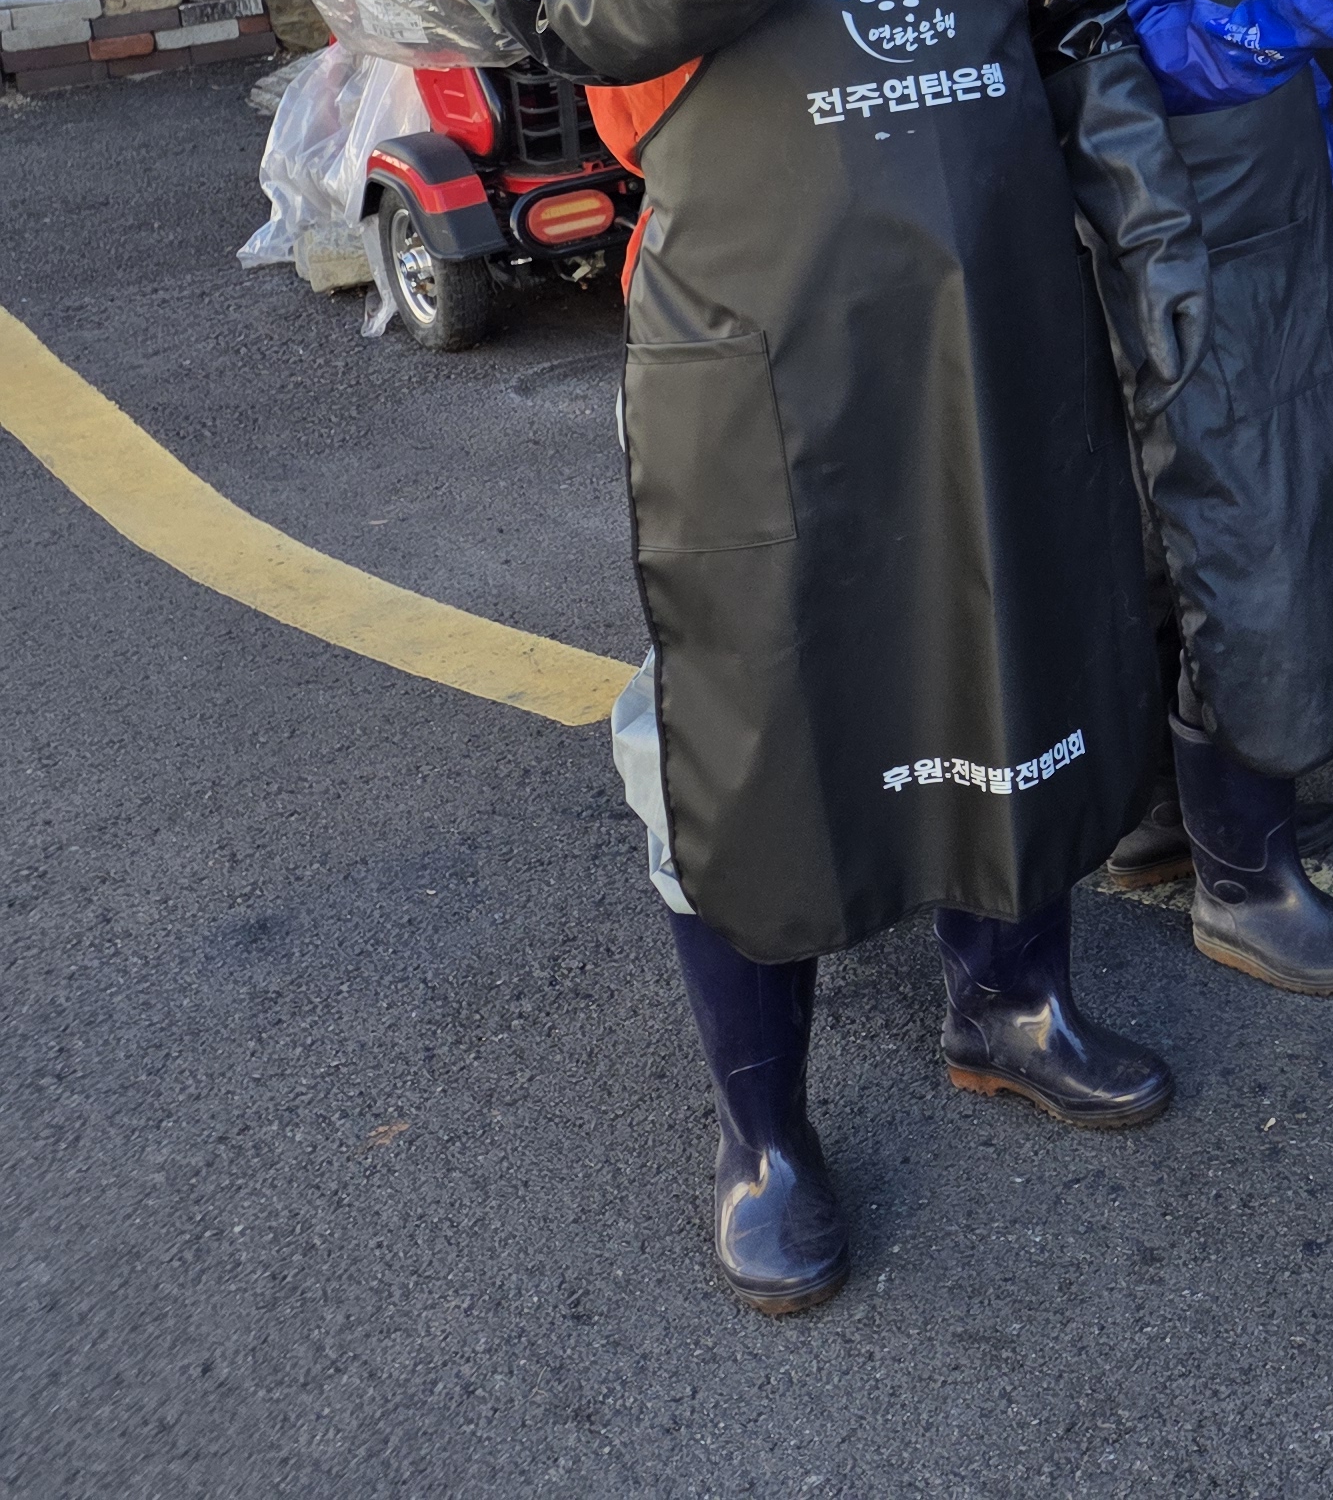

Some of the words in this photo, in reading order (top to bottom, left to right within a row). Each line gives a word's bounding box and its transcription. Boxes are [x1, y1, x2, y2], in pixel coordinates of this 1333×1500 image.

[868, 8, 955, 51] 연탄은행
[807, 62, 1006, 125] 전주연탄은행
[883, 728, 1086, 795] 후원:전북발전협의회
